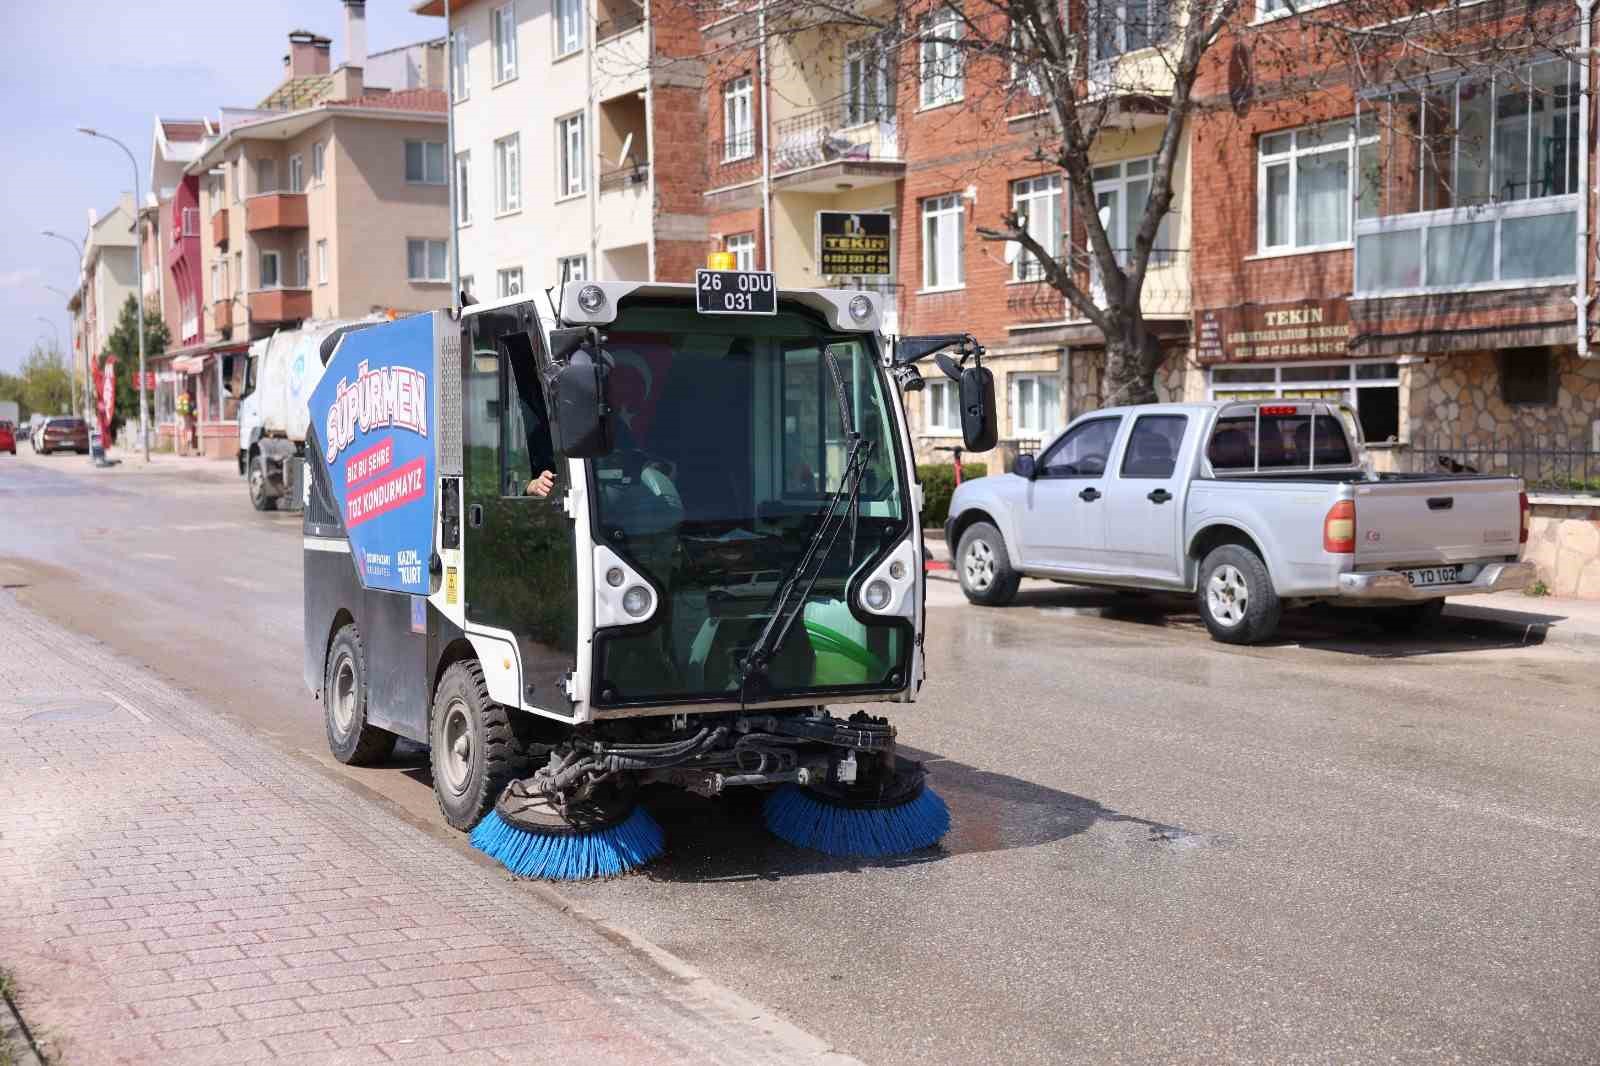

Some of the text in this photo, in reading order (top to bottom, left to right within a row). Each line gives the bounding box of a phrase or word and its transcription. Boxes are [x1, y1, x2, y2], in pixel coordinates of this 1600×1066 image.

[701, 273, 772, 292] 26 ODU
[724, 293, 752, 310] 031
[1264, 304, 1323, 326] TEKİN
[326, 359, 428, 464] SÜPÜRMEN
[347, 446, 391, 483] BİZ BU ŞEHRE
[348, 467, 422, 521] TOZ KONDURMAYIZ
[397, 549, 420, 566] KAZIM
[399, 566, 421, 584] KURT
[1419, 569, 1434, 583] YD
[1437, 568, 1456, 582] 102
